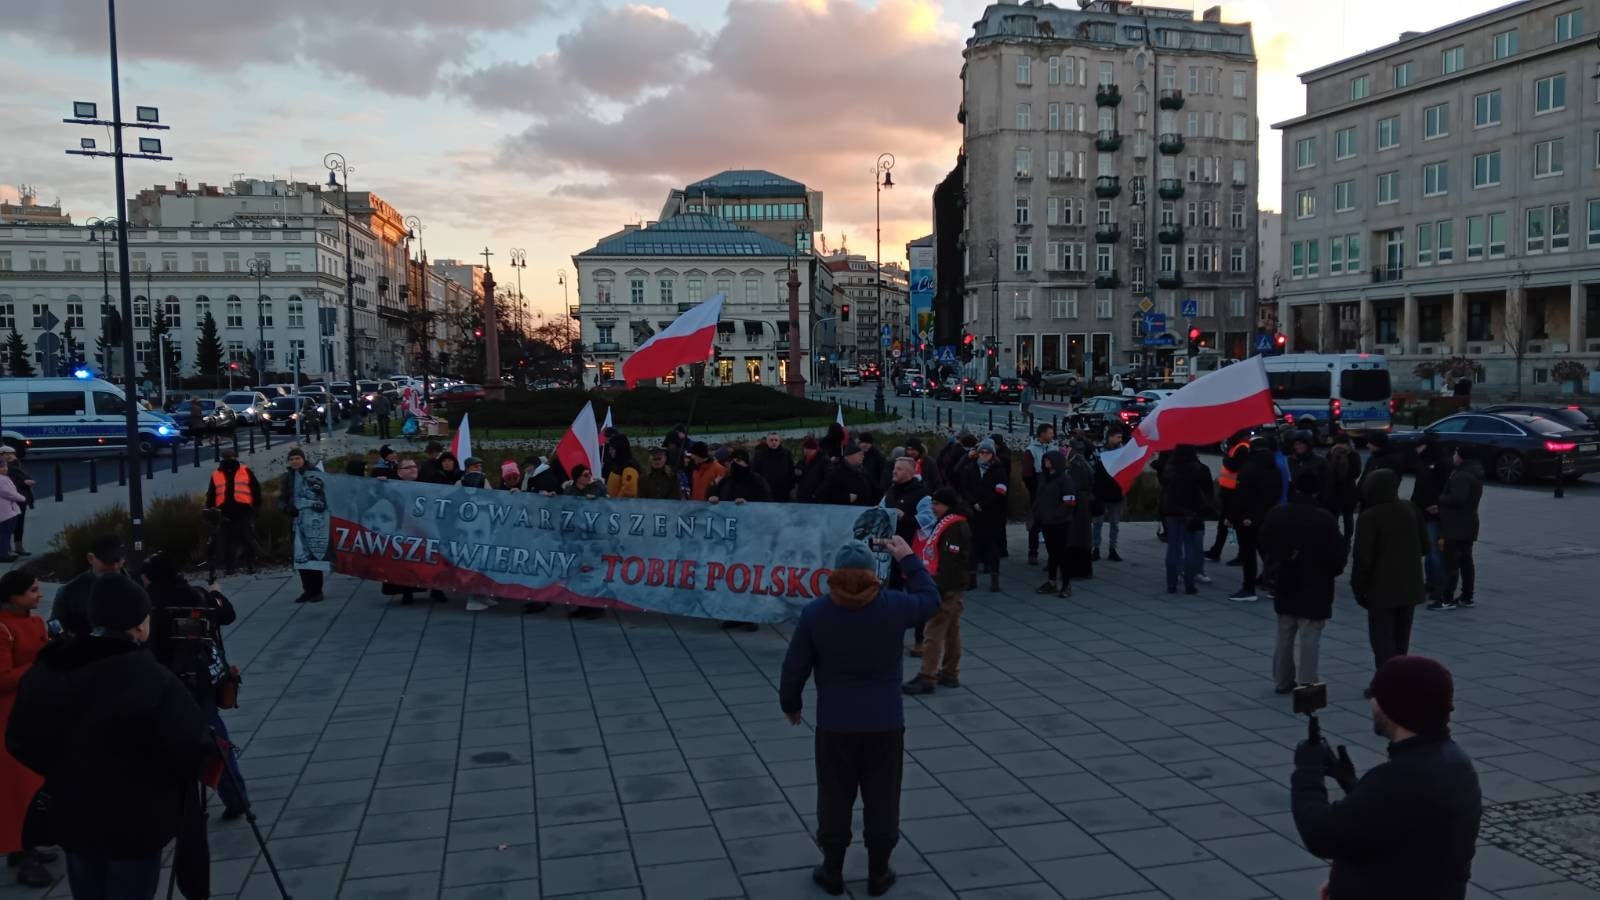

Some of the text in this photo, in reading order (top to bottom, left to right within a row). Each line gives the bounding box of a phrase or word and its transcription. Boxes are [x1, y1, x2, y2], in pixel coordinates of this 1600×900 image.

[42, 426, 78, 435] POLICJA
[413, 496, 738, 541] STOWARZYSZENIE
[335, 528, 441, 566] ZAWSZE
[450, 542, 577, 579] WIERNY
[602, 554, 697, 592] TOBIE
